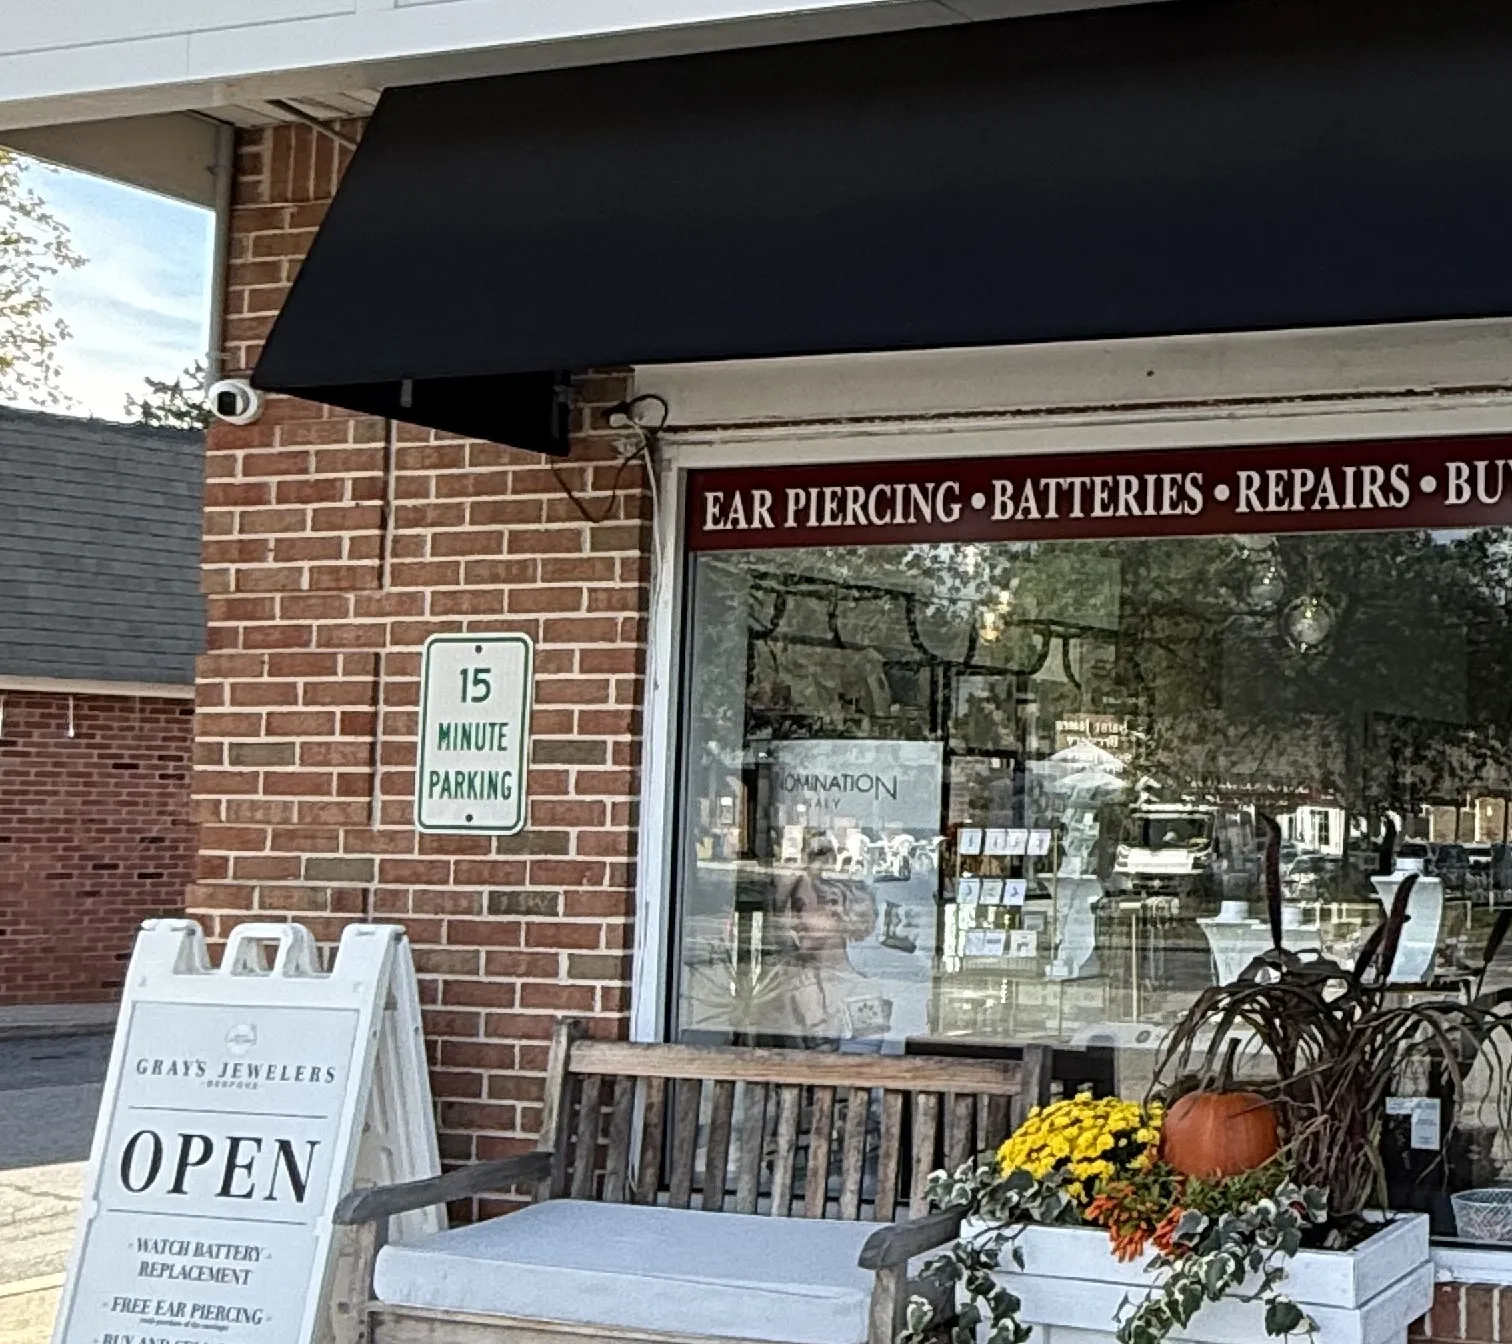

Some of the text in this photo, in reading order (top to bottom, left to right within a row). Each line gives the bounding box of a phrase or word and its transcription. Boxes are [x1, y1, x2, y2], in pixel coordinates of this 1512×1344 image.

[703, 490, 775, 531] EAR
[783, 480, 962, 528] PIERCING
[991, 471, 1203, 521] BATTERIES
[1235, 463, 1410, 513] REPAIRS
[460, 667, 491, 703] 15
[437, 722, 509, 751] MINUTE
[428, 770, 512, 800] PARKING
[136, 1058, 336, 1084] GRAY'S JEWELERS
[120, 1130, 322, 1204] OPEN
[136, 1237, 264, 1262] WATCH BATTERY
[138, 1260, 253, 1286] REPLACEMENT
[111, 1296, 151, 1314] FREE
[154, 1299, 187, 1318] EAR
[190, 1303, 263, 1326] PIERCING
